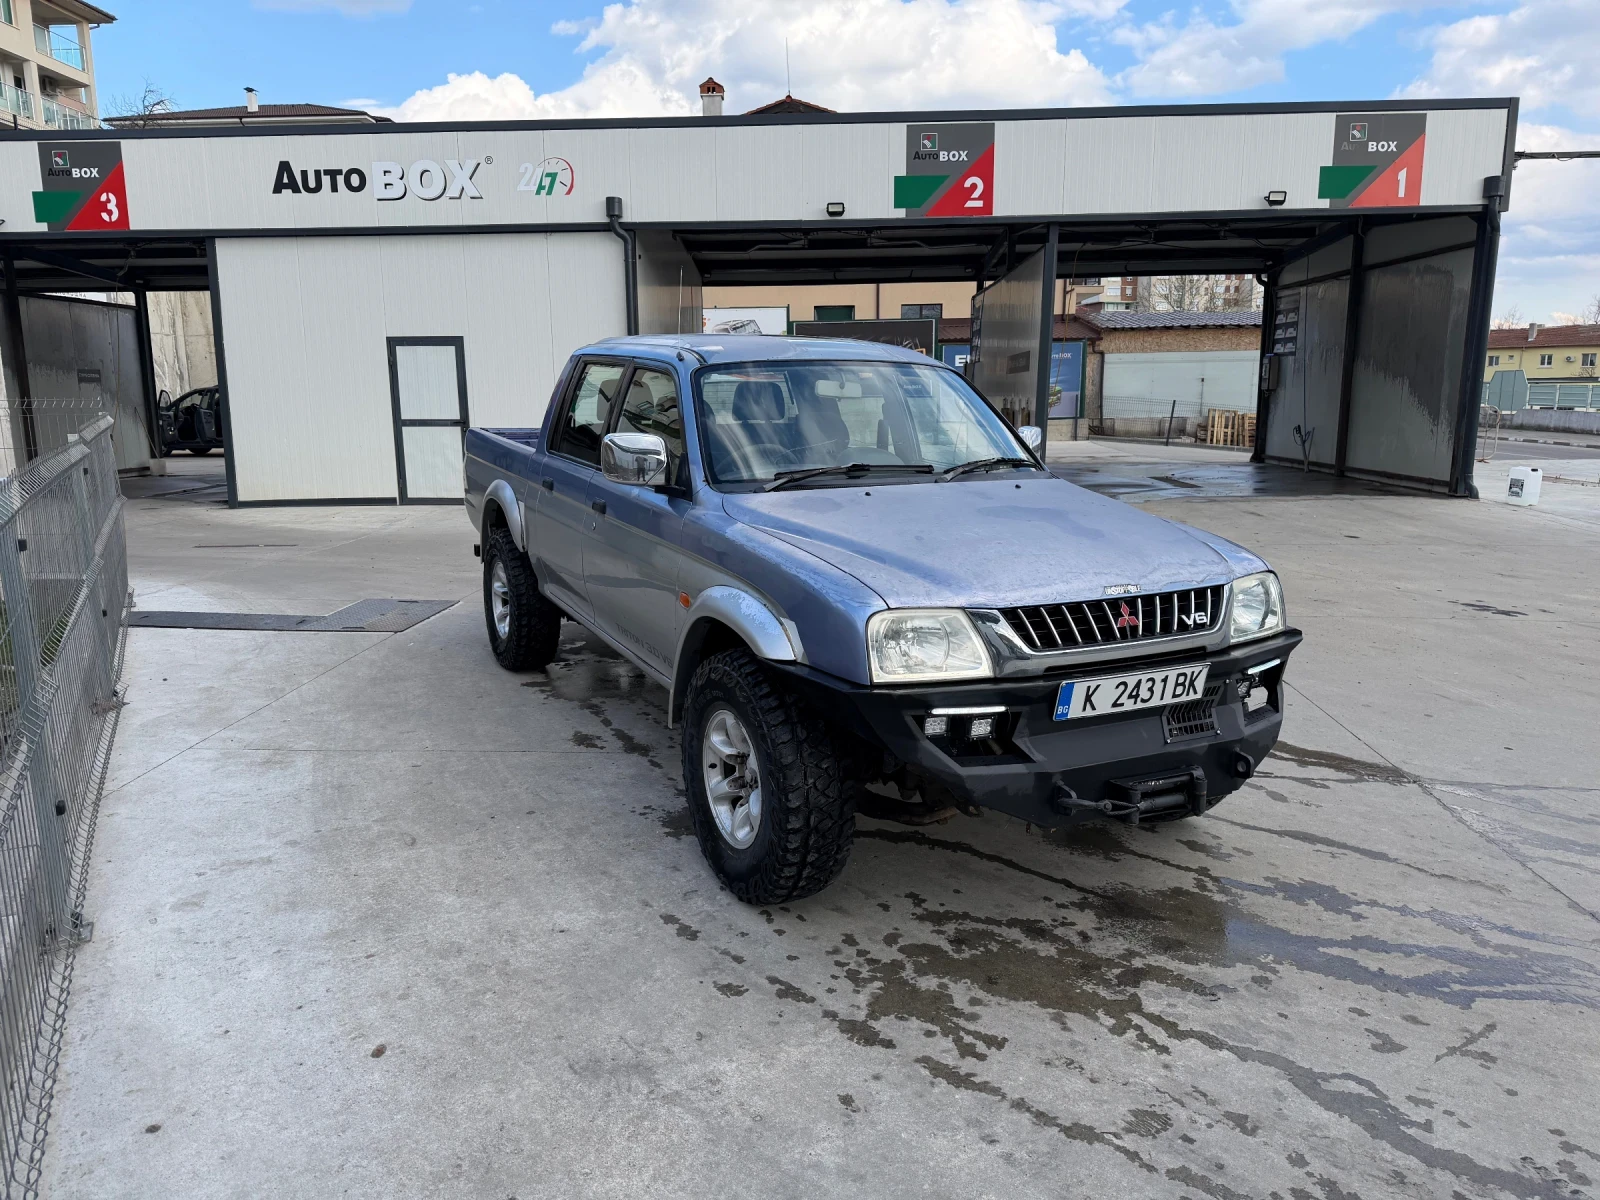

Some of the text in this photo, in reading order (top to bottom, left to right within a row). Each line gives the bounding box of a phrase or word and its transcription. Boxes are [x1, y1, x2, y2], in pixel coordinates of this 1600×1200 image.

[963, 176, 984, 208] 2
[1397, 166, 1407, 198] 1
[99, 192, 119, 223] 3
[1180, 611, 1208, 626] V6
[1057, 705, 1069, 714] BG
[1081, 683, 1102, 712] K
